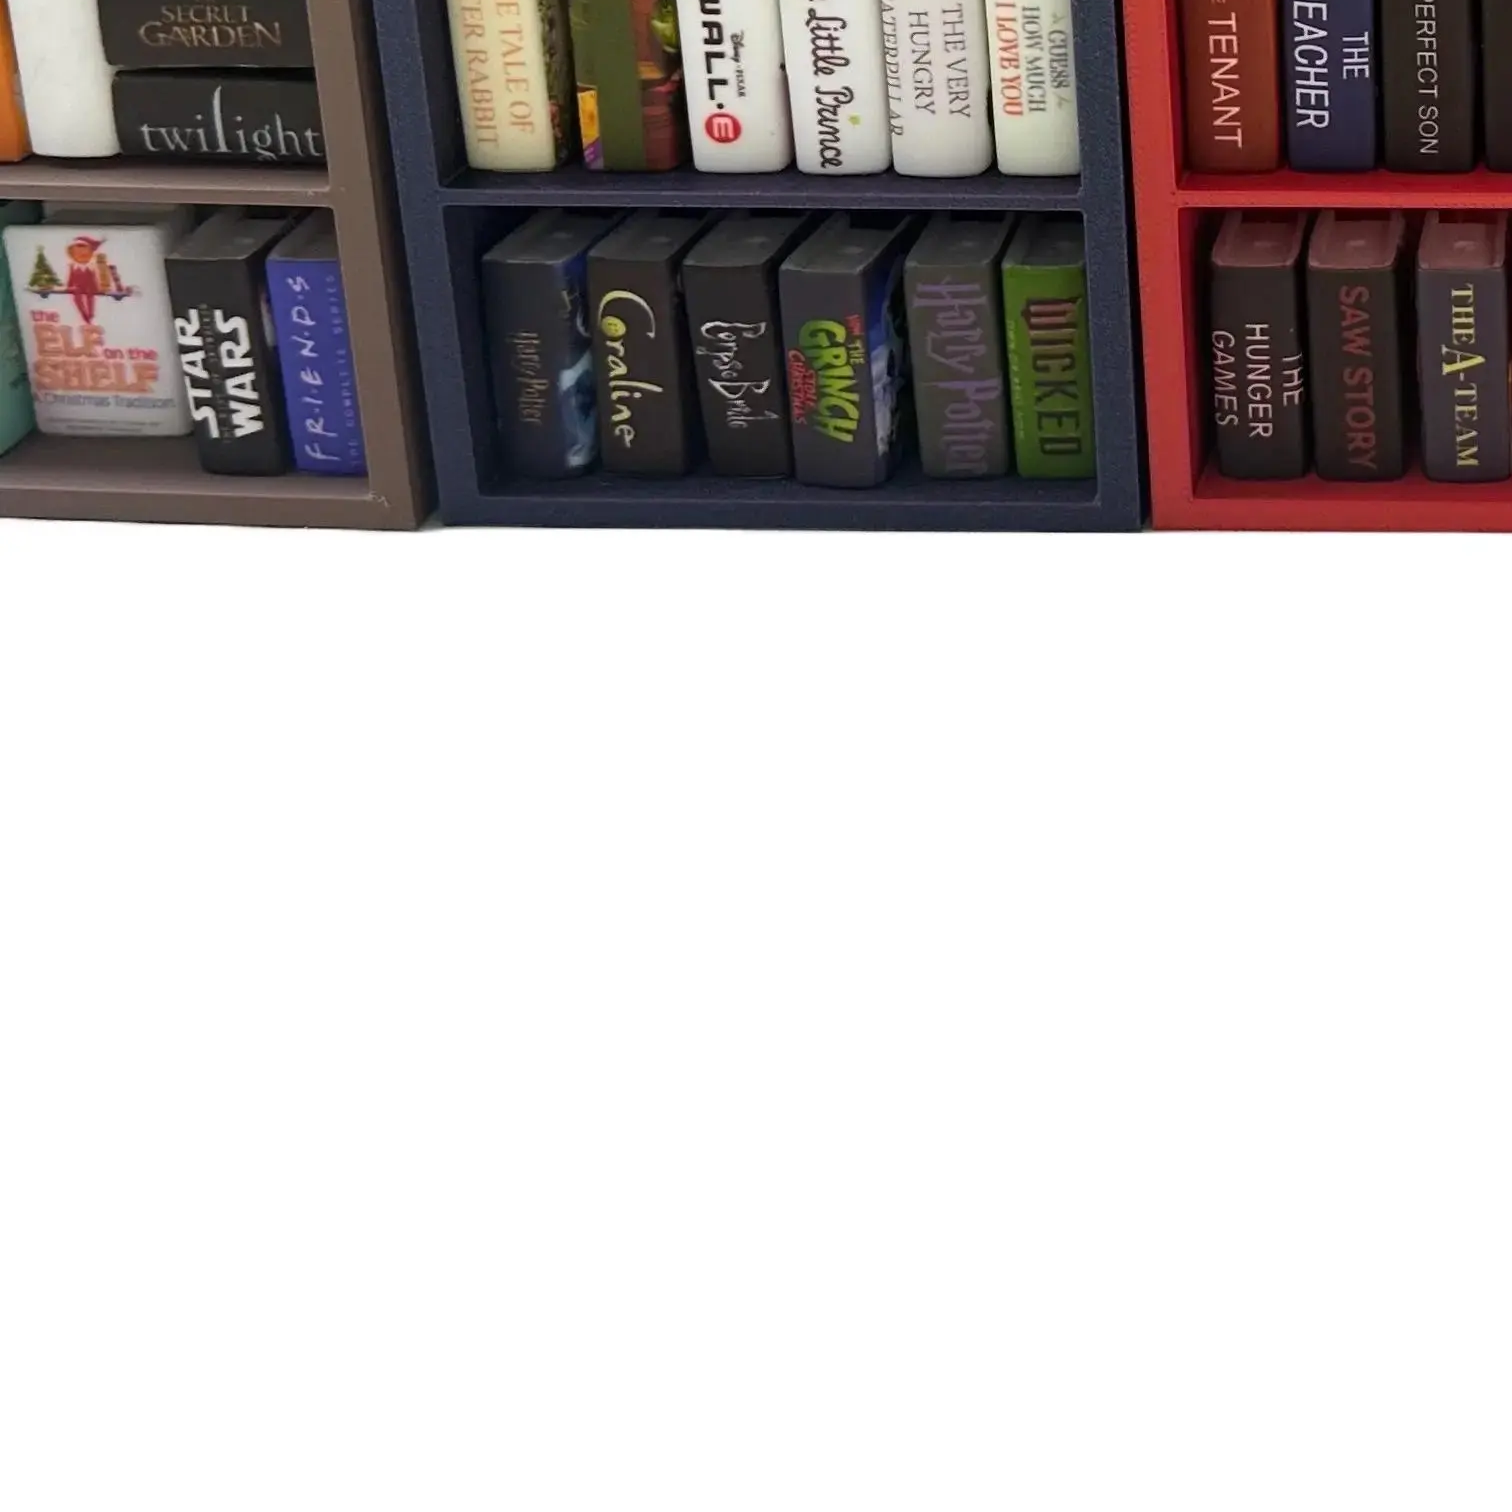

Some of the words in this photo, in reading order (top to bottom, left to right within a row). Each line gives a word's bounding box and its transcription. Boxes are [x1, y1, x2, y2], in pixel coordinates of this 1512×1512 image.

[138, 21, 282, 49] GARDEN
[160, 4, 250, 23] SECRET
[941, 2, 966, 53] THE
[994, 1, 1017, 9] I
[1022, 6, 1044, 49] HOW
[499, 29, 530, 93] TALE
[805, 7, 851, 76] Little
[908, 10, 936, 115] HUNGRY
[994, 17, 1021, 70] LOVE
[1047, 29, 1071, 88] GUESS
[1342, 31, 1369, 80] THE
[466, 49, 500, 147] RABBIT
[947, 59, 972, 119] VERY
[1000, 77, 1024, 117] YOU
[1026, 55, 1047, 114] MUCH
[1208, 12, 1243, 150] TENANT
[139, 85, 324, 161] twilight
[507, 99, 535, 136] OF
[814, 86, 855, 170] Prince
[1418, 105, 1439, 154] SON
[30, 309, 60, 324] the
[32, 323, 105, 358] ELF
[103, 349, 124, 361] on
[127, 347, 158, 361] the
[911, 276, 988, 374] Harry
[1339, 285, 1372, 358] SAW
[1451, 283, 1475, 345] THE
[175, 309, 220, 438] STAR
[214, 309, 264, 437] WARS
[597, 289, 664, 449] Coraline
[799, 319, 860, 442] GRINCH
[847, 339, 865, 365] THE
[1022, 296, 1082, 456] WICKED
[1211, 330, 1239, 427] GAMES
[1244, 323, 1274, 438] HUNGER
[1282, 352, 1304, 407] THE
[921, 375, 1003, 475] Potter
[1342, 366, 1377, 470] STORY
[1440, 344, 1486, 467] A-TEAM
